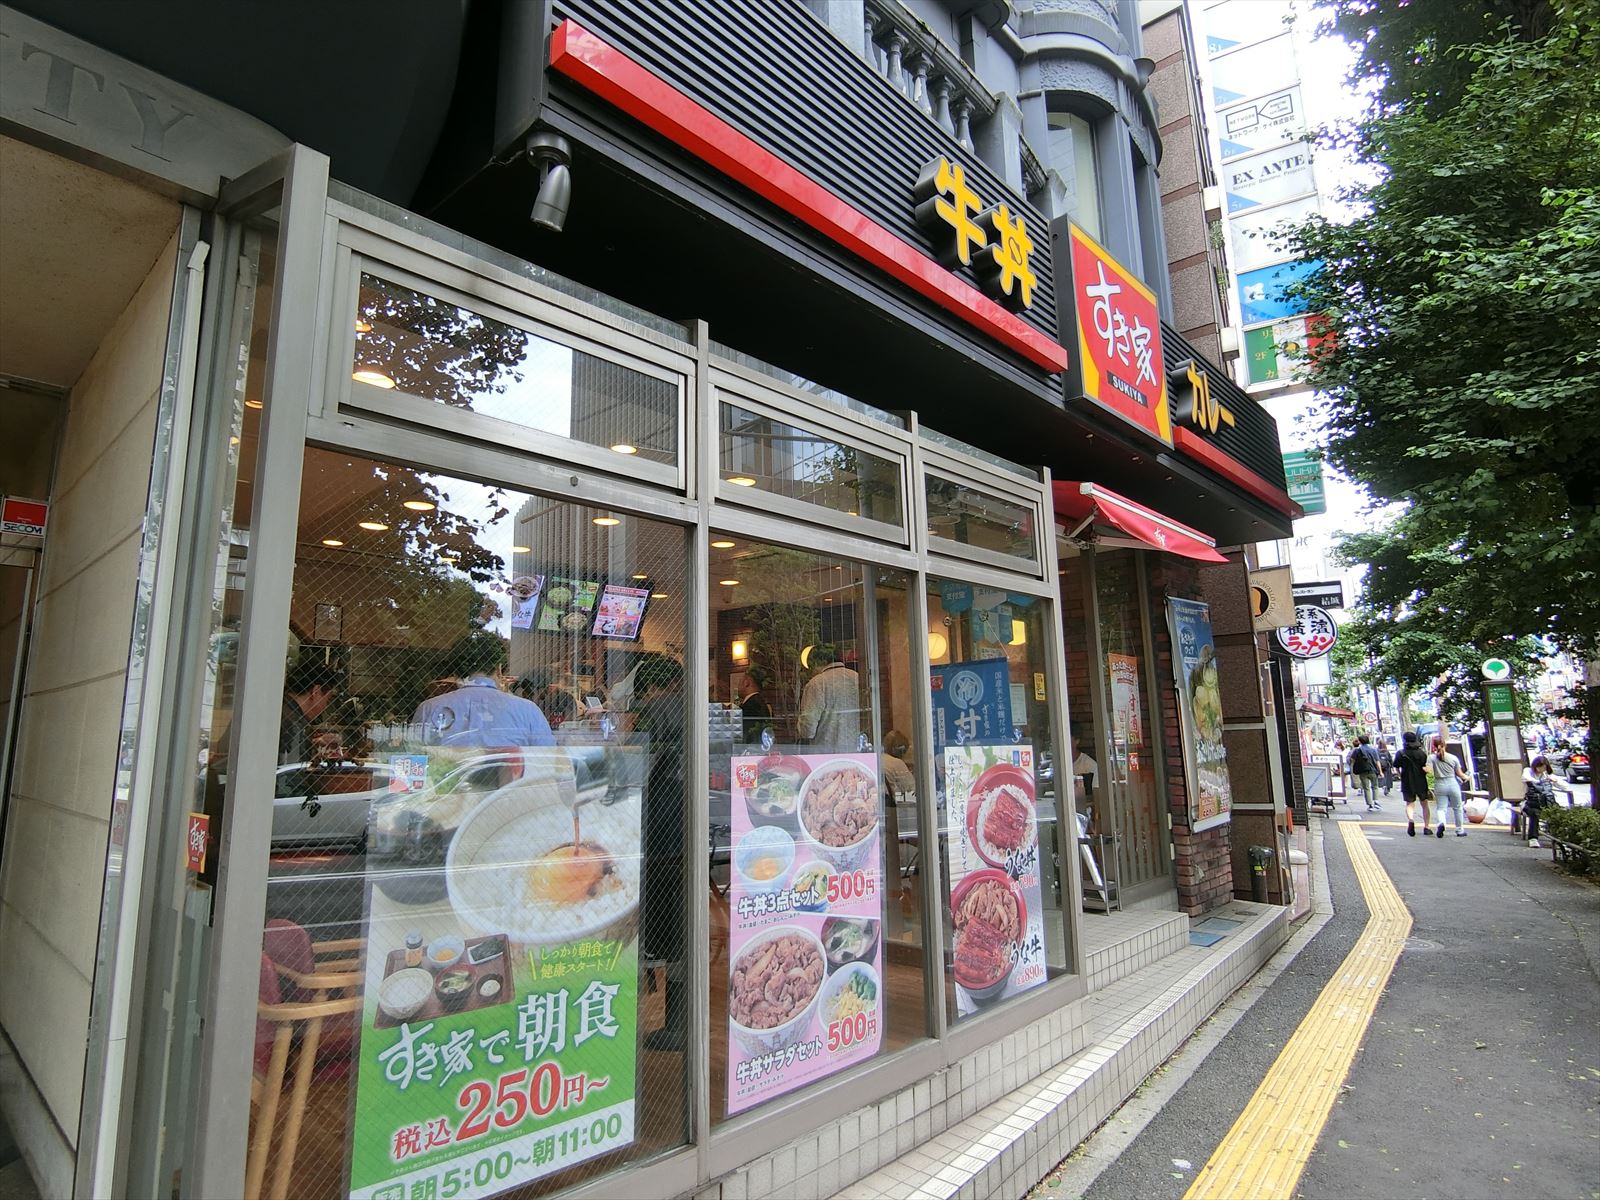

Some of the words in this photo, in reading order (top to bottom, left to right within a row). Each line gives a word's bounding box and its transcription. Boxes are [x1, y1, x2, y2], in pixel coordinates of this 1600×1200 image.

[0, 33, 194, 163] TY
[1232, 168, 1254, 186] EX
[1261, 154, 1306, 177] ANTE
[936, 155, 1039, 310] 牛丼
[1086, 260, 1157, 387] すき家
[1254, 351, 1267, 361] 2F
[1111, 376, 1144, 405] SUKIYA
[1187, 359, 1236, 435] カレー
[4, 522, 43, 535] SECOM
[1286, 634, 1335, 655] ラーメン
[737, 886, 820, 920] 牛丼3点セット
[827, 869, 876, 903] 500円
[1011, 934, 1042, 968] うな牛
[378, 980, 620, 1090] すき家で朝食
[827, 1012, 877, 1053] 500円
[736, 1035, 824, 1086] 牛丼サラダセット
